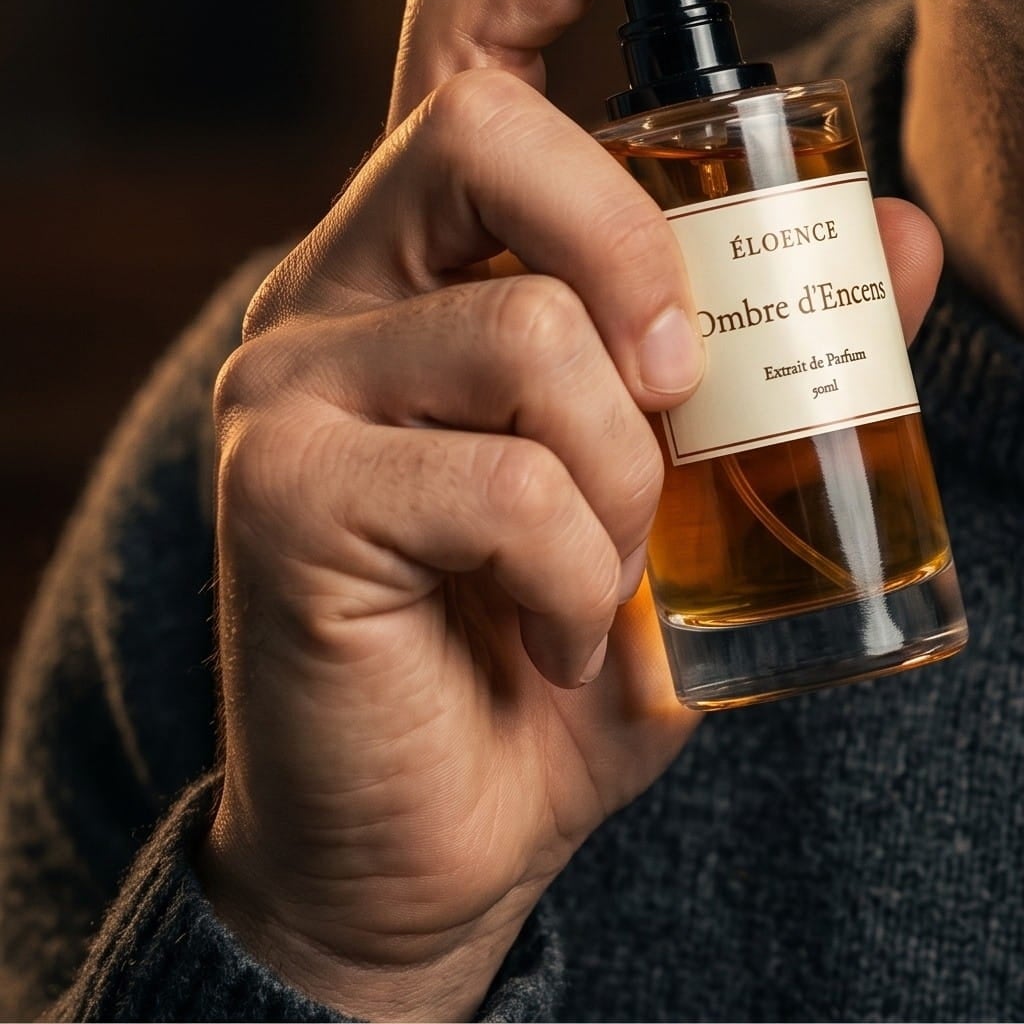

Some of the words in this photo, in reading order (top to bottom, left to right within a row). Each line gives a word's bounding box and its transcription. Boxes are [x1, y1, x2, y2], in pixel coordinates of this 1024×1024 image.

[729, 220, 839, 260] ÉLOENCE
[763, 360, 808, 381] Extrait
[809, 357, 825, 371] de
[826, 348, 867, 367] Parfum
[812, 380, 839, 399] 50ml
